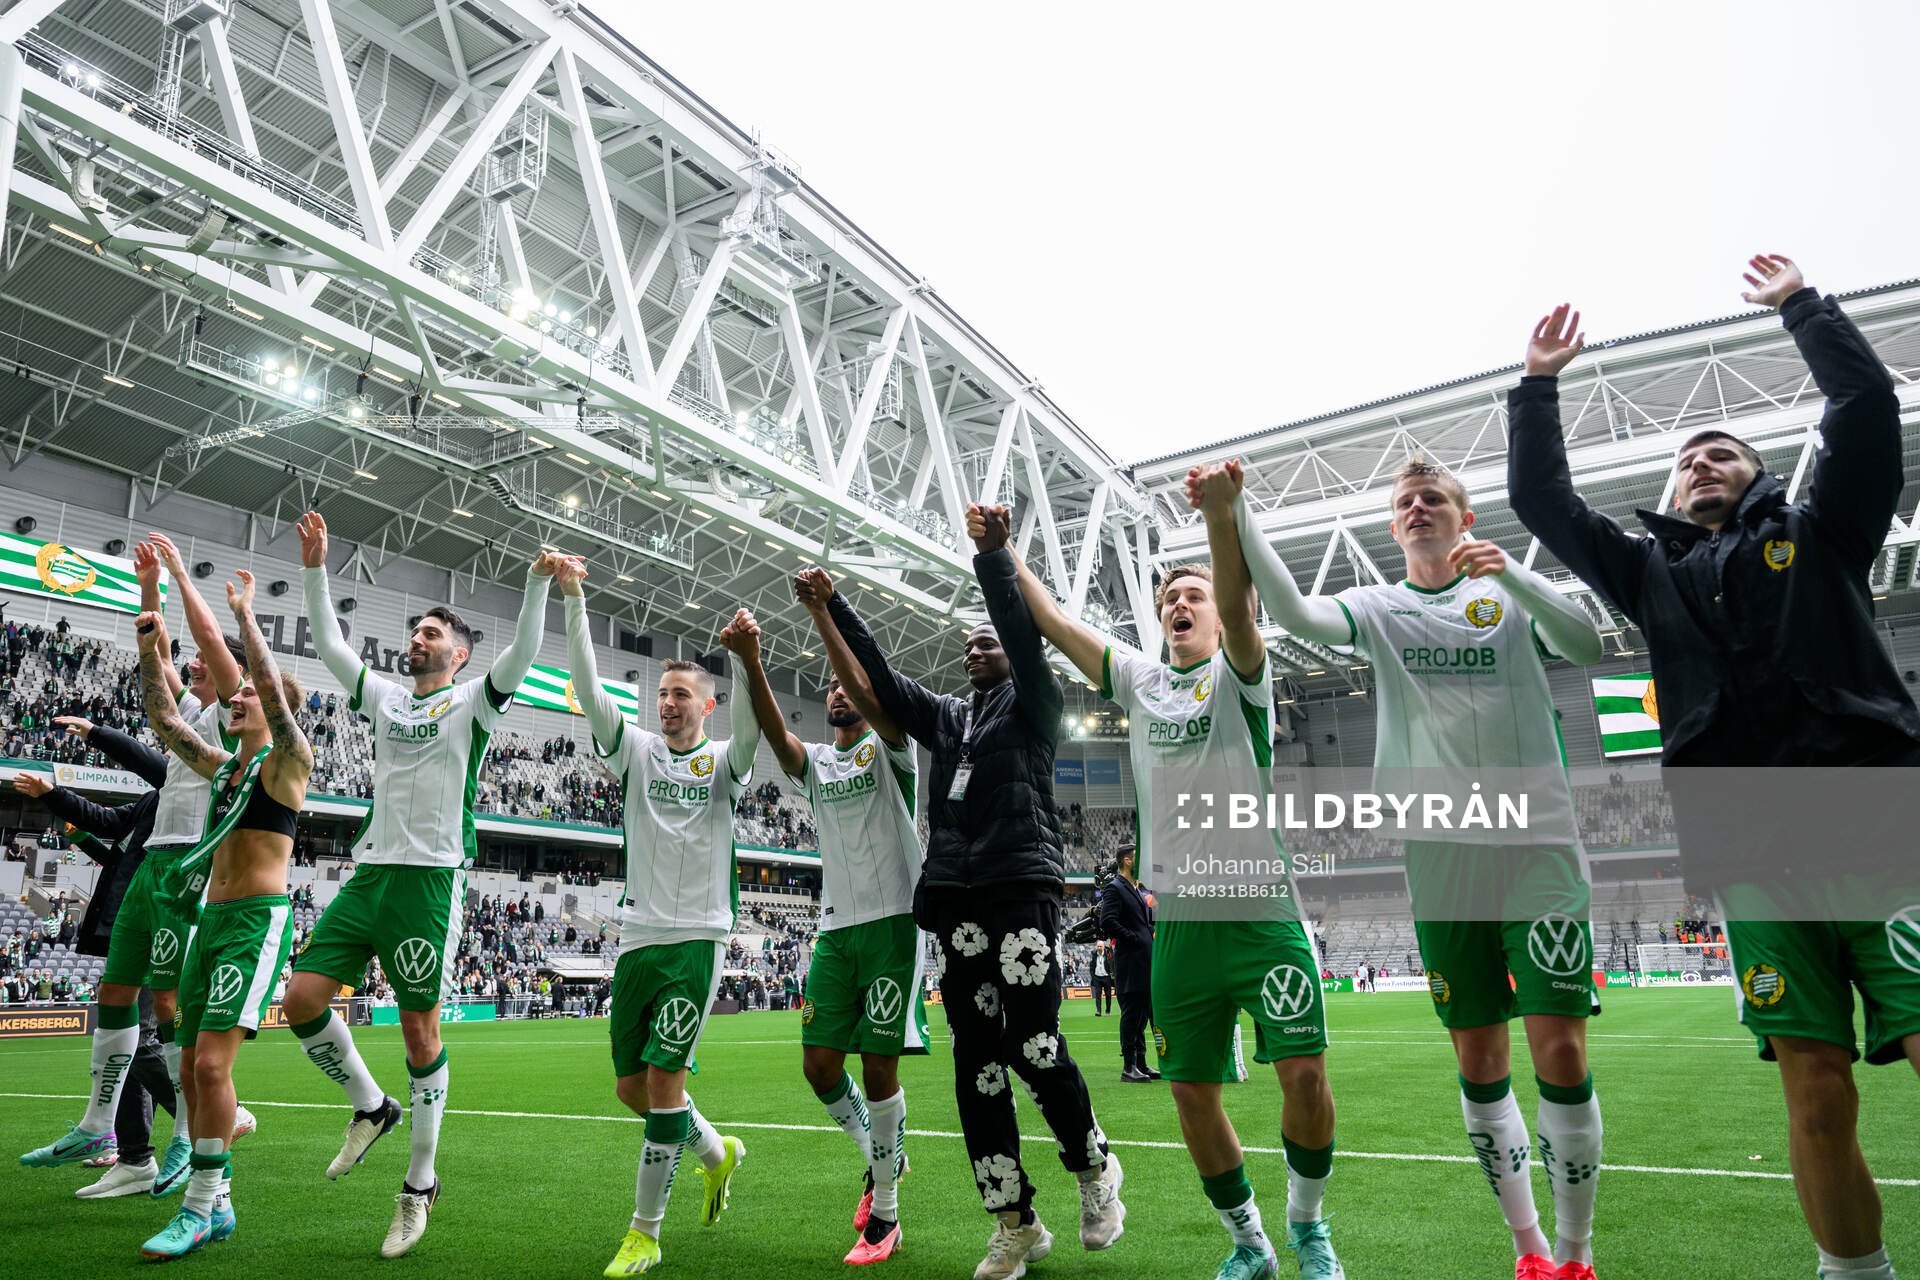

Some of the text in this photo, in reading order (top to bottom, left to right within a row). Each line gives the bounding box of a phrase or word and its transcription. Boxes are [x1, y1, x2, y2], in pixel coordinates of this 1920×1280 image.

[1403, 647, 1496, 667] PROJOB
[1148, 715, 1211, 740] PROOB
[76, 773, 117, 784] LIMPAN
[121, 776, 128, 785] 4
[819, 772, 876, 798] PROJOB
[648, 779, 709, 801] PROJOB
[1647, 974, 1680, 984] Pendax
[1552, 981, 1583, 991] CRAFT
[872, 1027, 895, 1037] CRAFT
[1283, 1026, 1313, 1034] CRAFT
[660, 1043, 682, 1055] CRAFT
